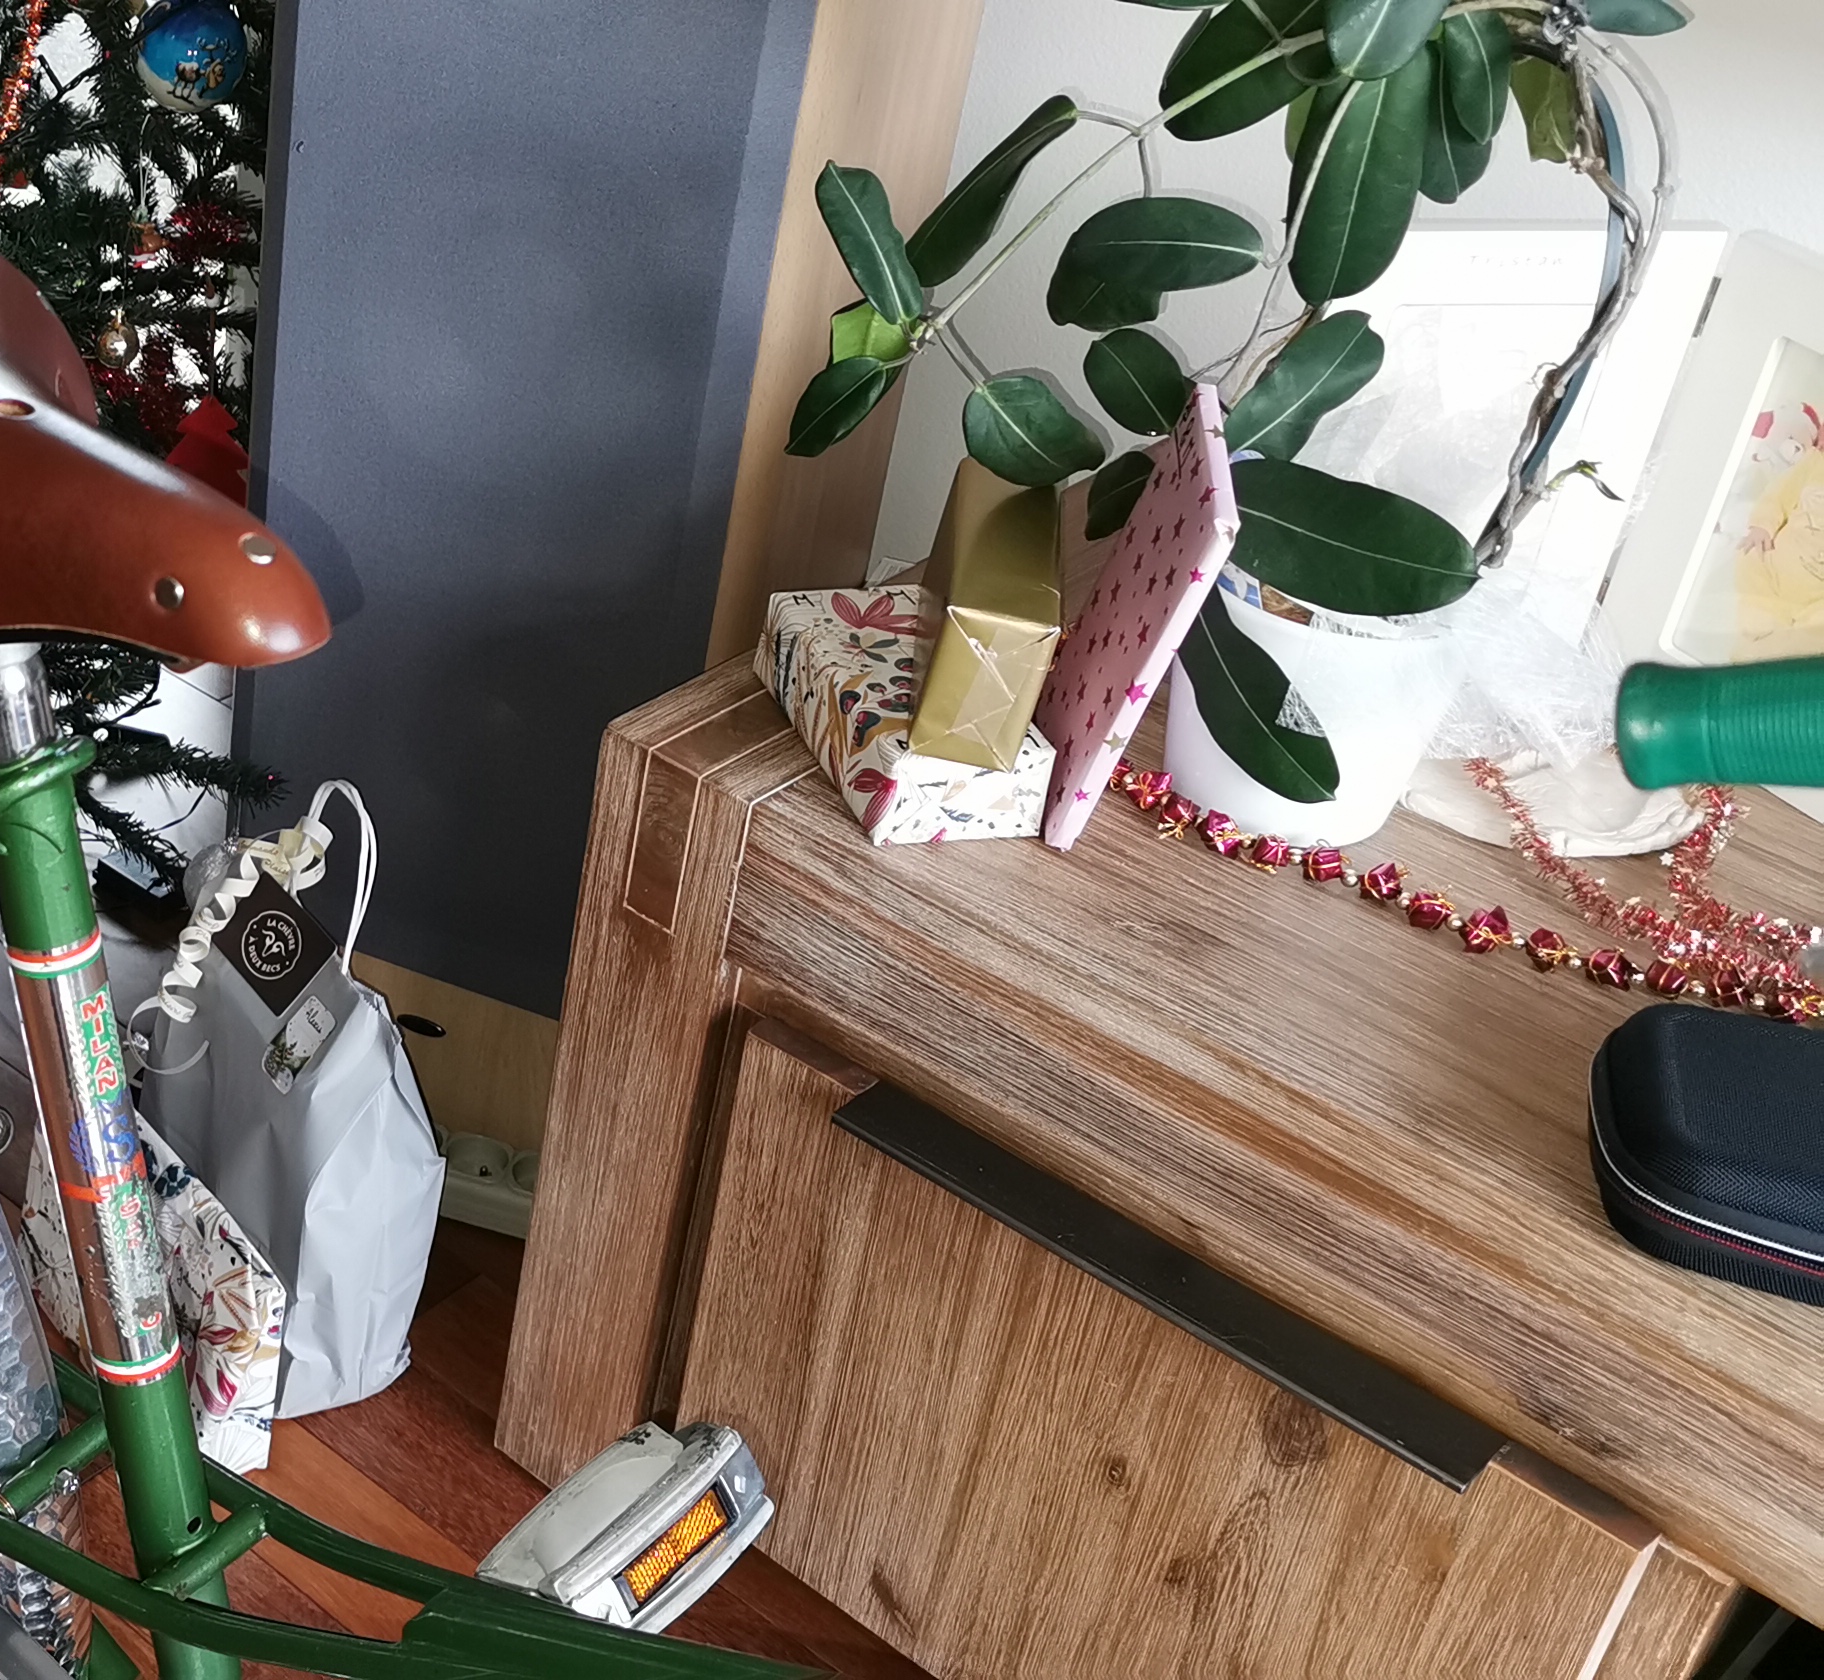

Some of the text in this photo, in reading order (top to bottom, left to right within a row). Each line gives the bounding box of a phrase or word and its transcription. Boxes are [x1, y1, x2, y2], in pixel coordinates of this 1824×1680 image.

[267, 918, 296, 951] LA CHÈVRE
[248, 944, 262, 969] DEUX
[261, 963, 281, 973] BECS
[80, 991, 119, 1095] MILAN
